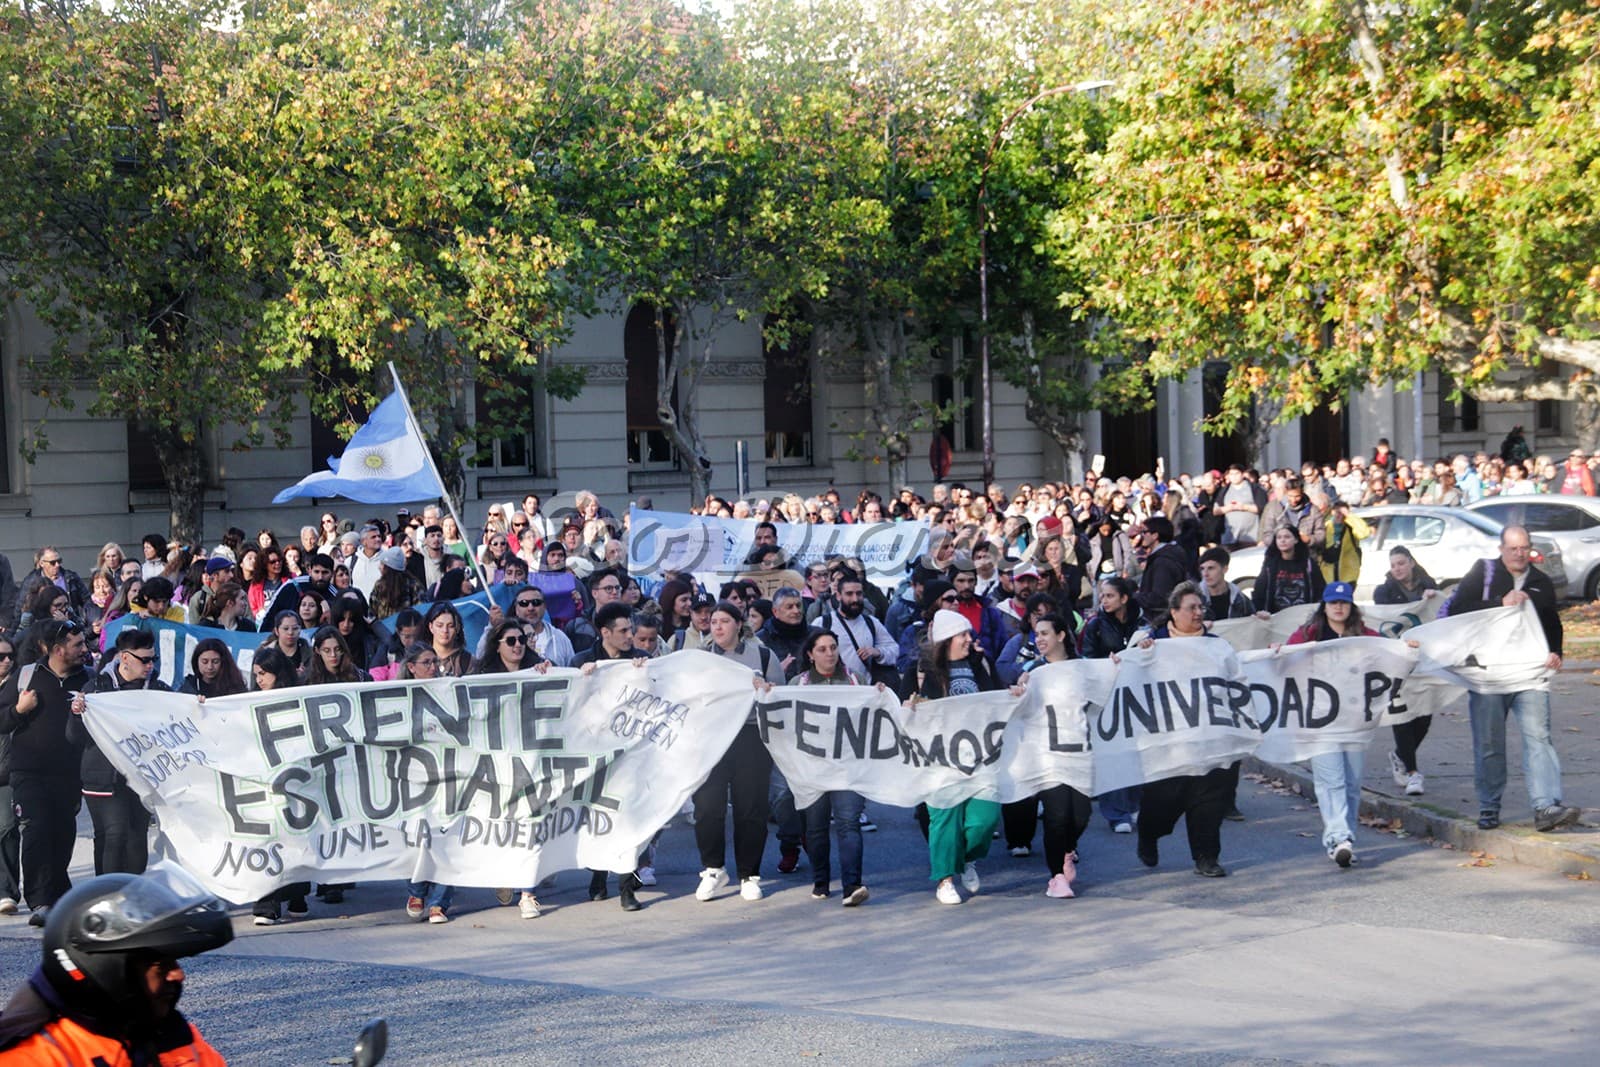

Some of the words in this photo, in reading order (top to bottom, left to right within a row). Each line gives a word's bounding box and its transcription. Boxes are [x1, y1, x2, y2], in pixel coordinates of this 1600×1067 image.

[253, 679, 570, 768] FRENTE
[213, 842, 284, 877] NOS
[319, 823, 389, 861] UNE
[401, 819, 432, 849] LA
[460, 806, 614, 851] DIVERSIDAD
